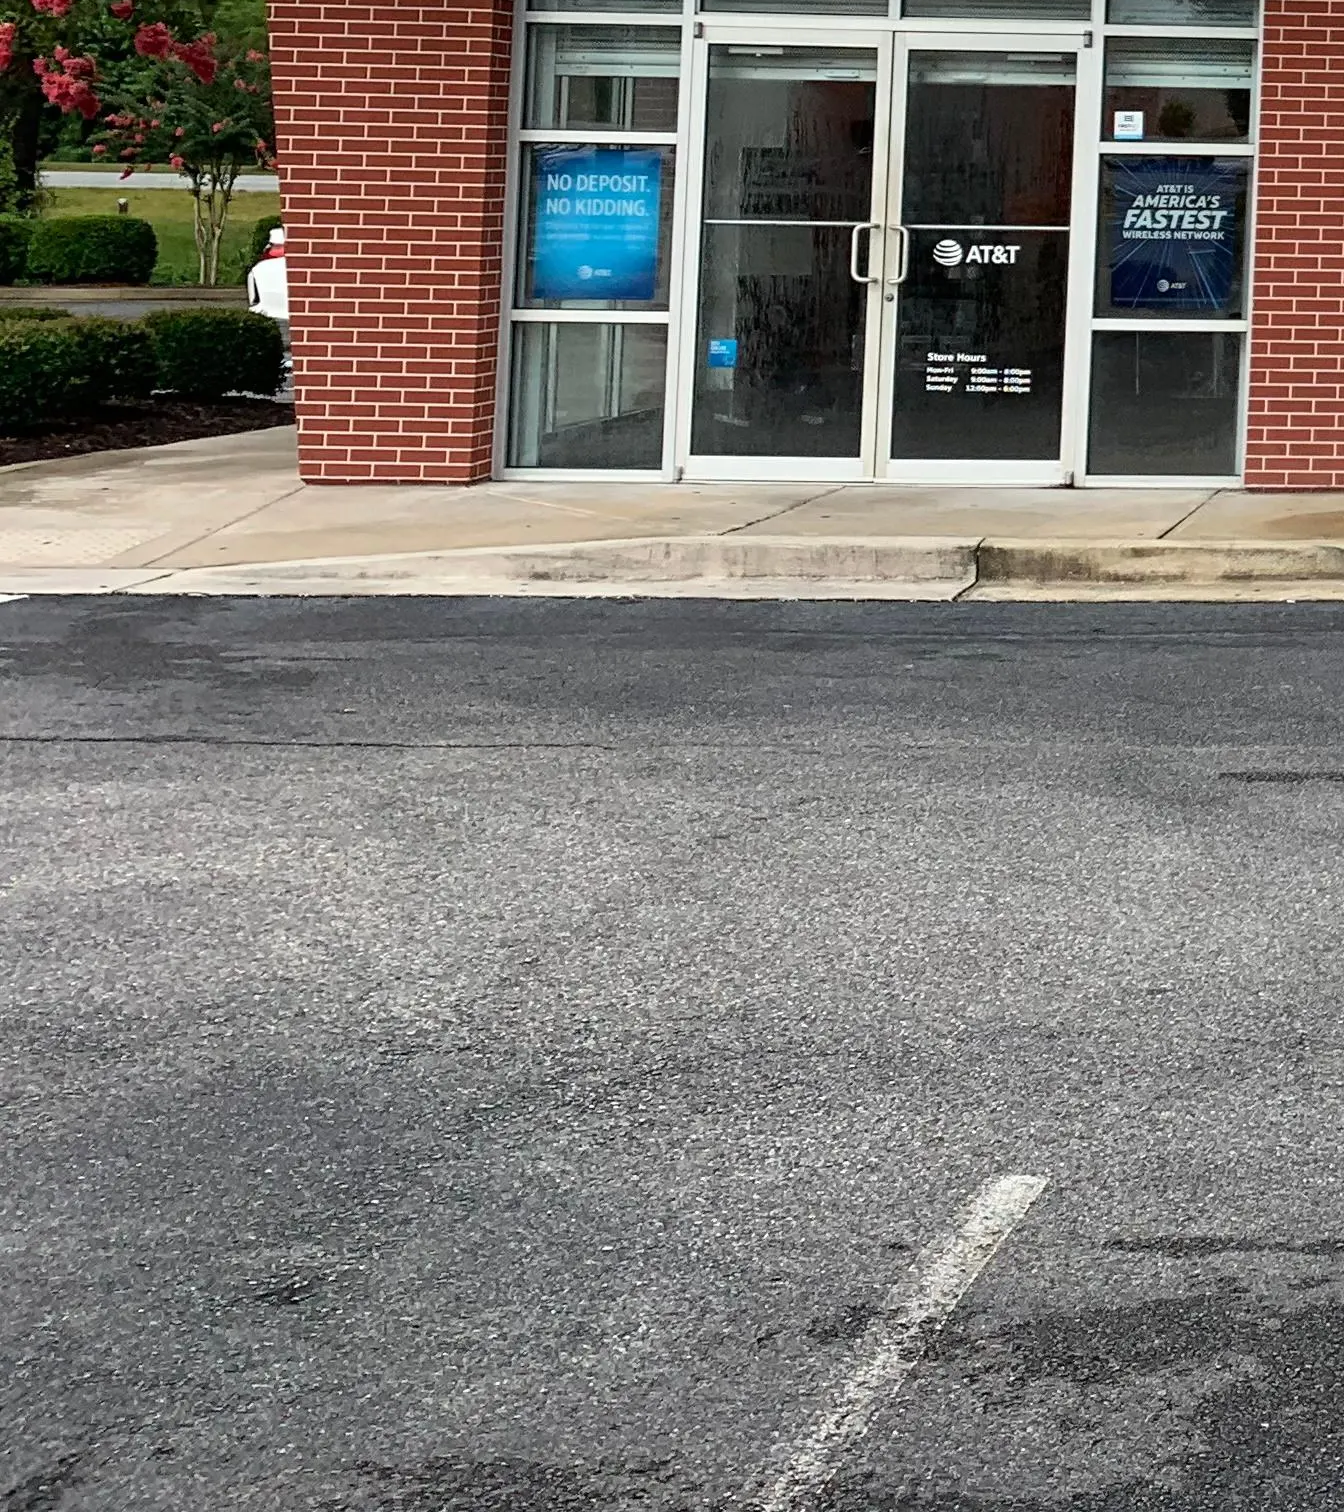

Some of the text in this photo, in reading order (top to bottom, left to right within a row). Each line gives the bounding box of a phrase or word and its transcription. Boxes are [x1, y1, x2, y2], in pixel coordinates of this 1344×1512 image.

[547, 174, 650, 193] NO DEPOSIT.
[1156, 184, 1194, 194] AT&T IS
[546, 198, 650, 217] NO KIDDING.
[1132, 194, 1221, 209] AMERICA'S
[1123, 209, 1228, 230] FASTEST
[1122, 230, 1225, 240] WIRELESS NETWORK
[965, 244, 1020, 264] AT&T
[927, 352, 987, 363] Store Hours
[926, 375, 959, 384] Saturday
[926, 384, 953, 392] Sunday
